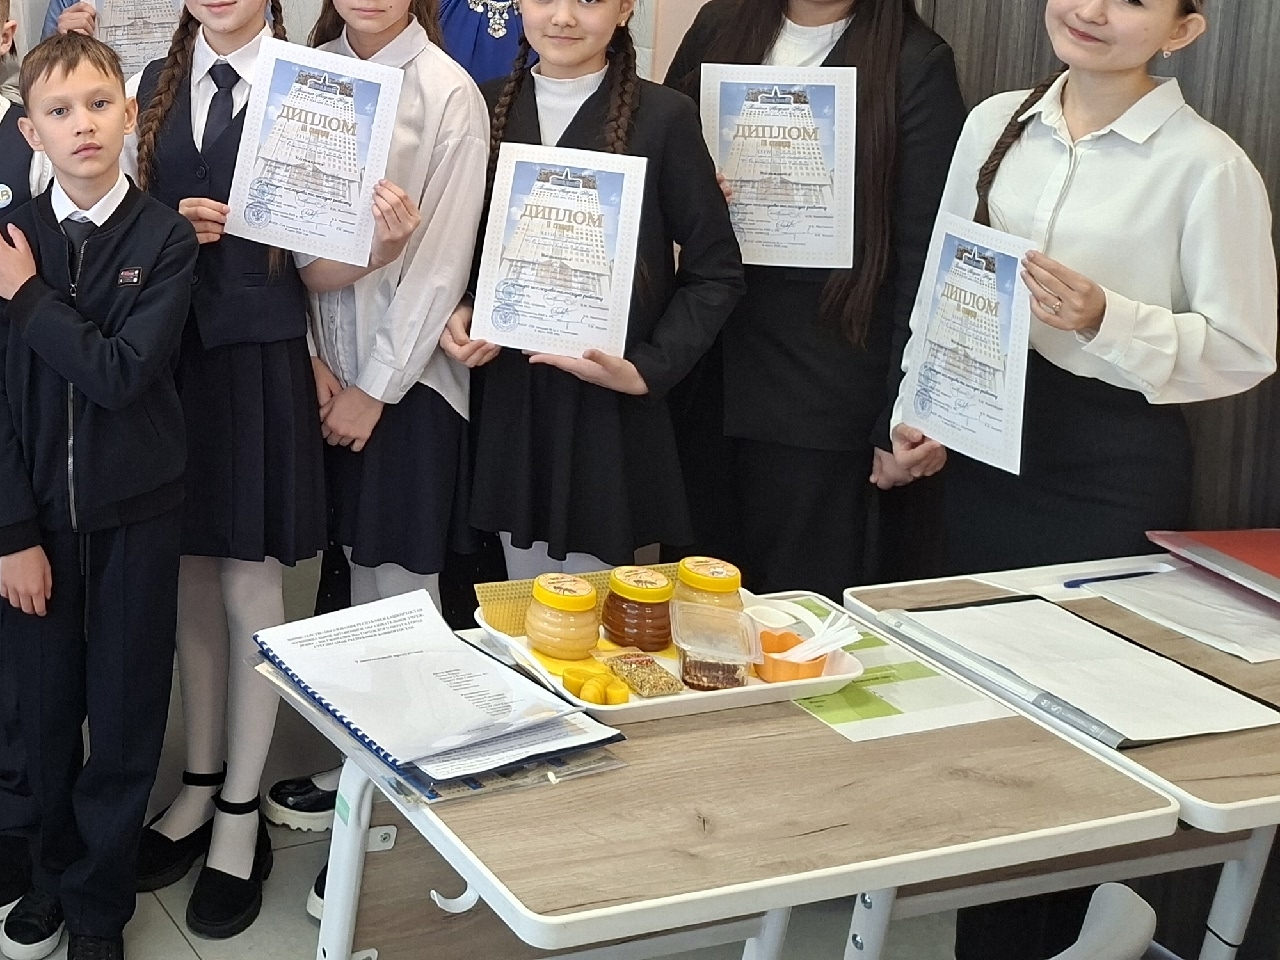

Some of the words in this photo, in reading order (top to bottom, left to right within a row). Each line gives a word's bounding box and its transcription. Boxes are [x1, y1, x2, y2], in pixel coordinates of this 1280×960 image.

[277, 103, 358, 136] ДИПЛОМ
[732, 123, 820, 141] ДИПЛОМ
[520, 203, 605, 228] ДИПЛОМ
[941, 281, 1000, 317] ДИПЛОМ
